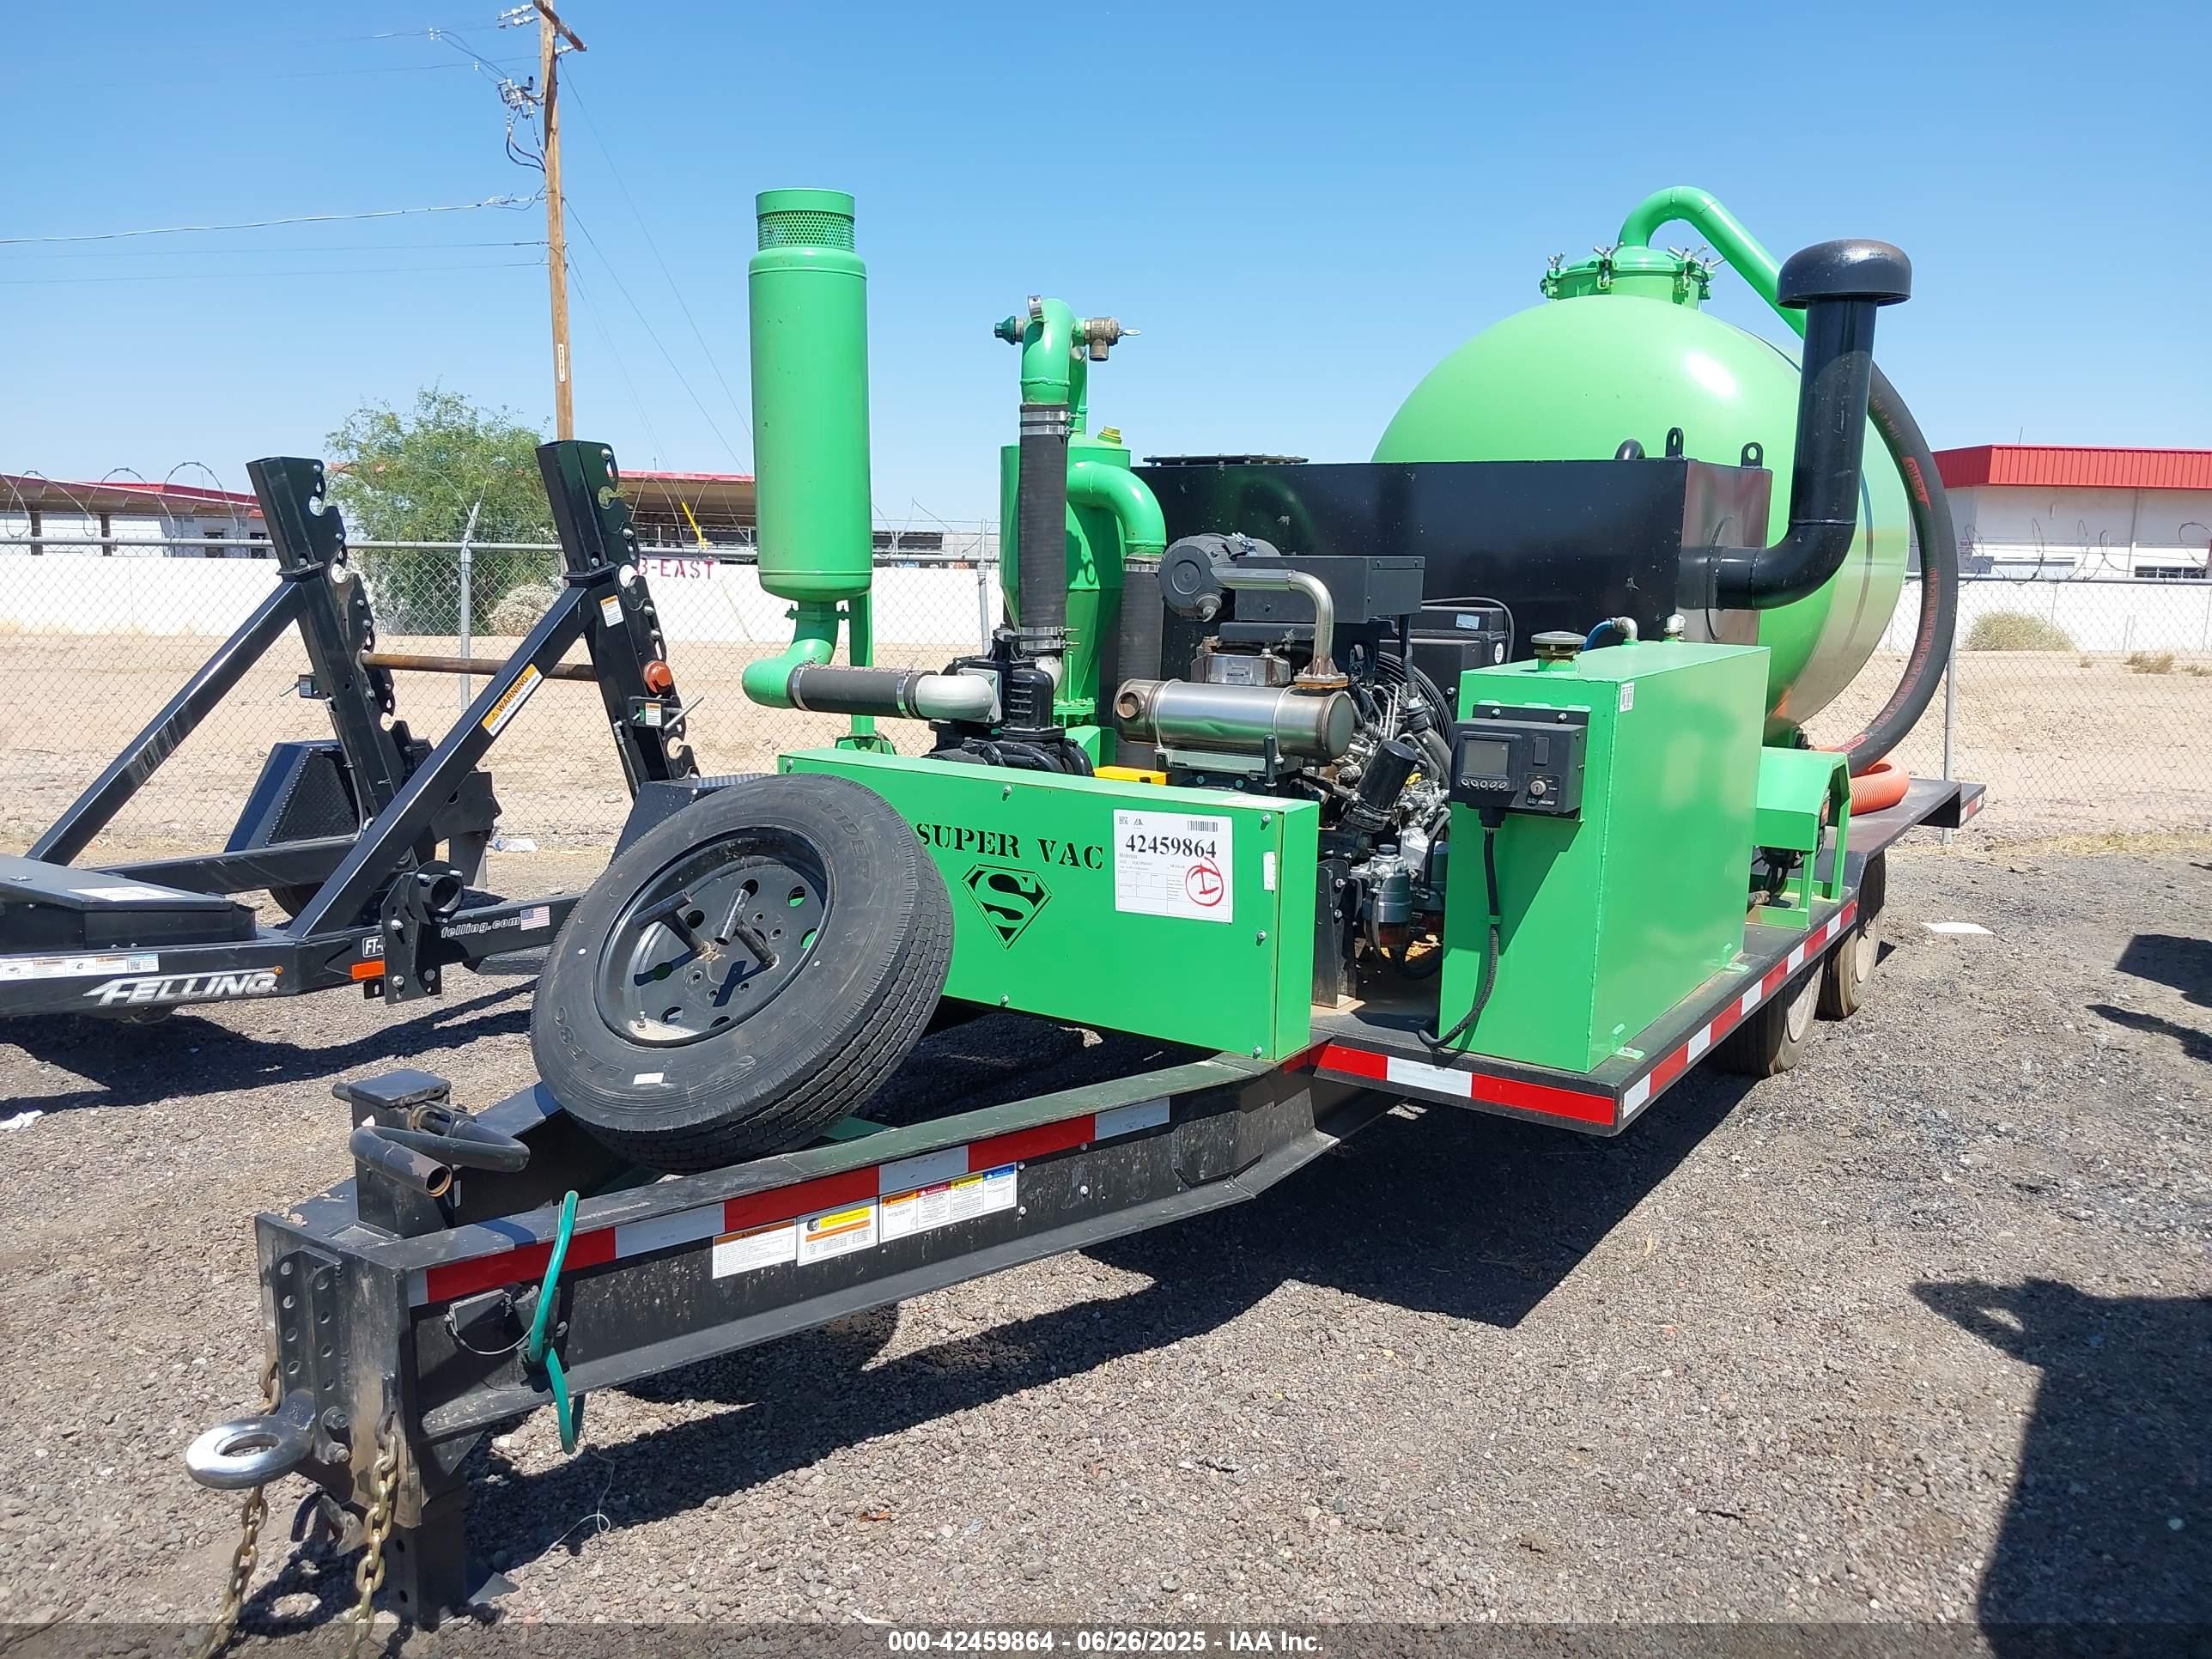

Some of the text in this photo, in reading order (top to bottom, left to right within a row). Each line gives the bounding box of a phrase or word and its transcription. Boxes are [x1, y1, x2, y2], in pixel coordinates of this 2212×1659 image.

[495, 674, 528, 712] WARNING
[915, 823, 1104, 870] SUPER VAC
[1125, 833, 1217, 859] 42459864
[441, 916, 520, 939] felling.com
[365, 938, 385, 955] FT-
[83, 968, 275, 1006] FELLING
